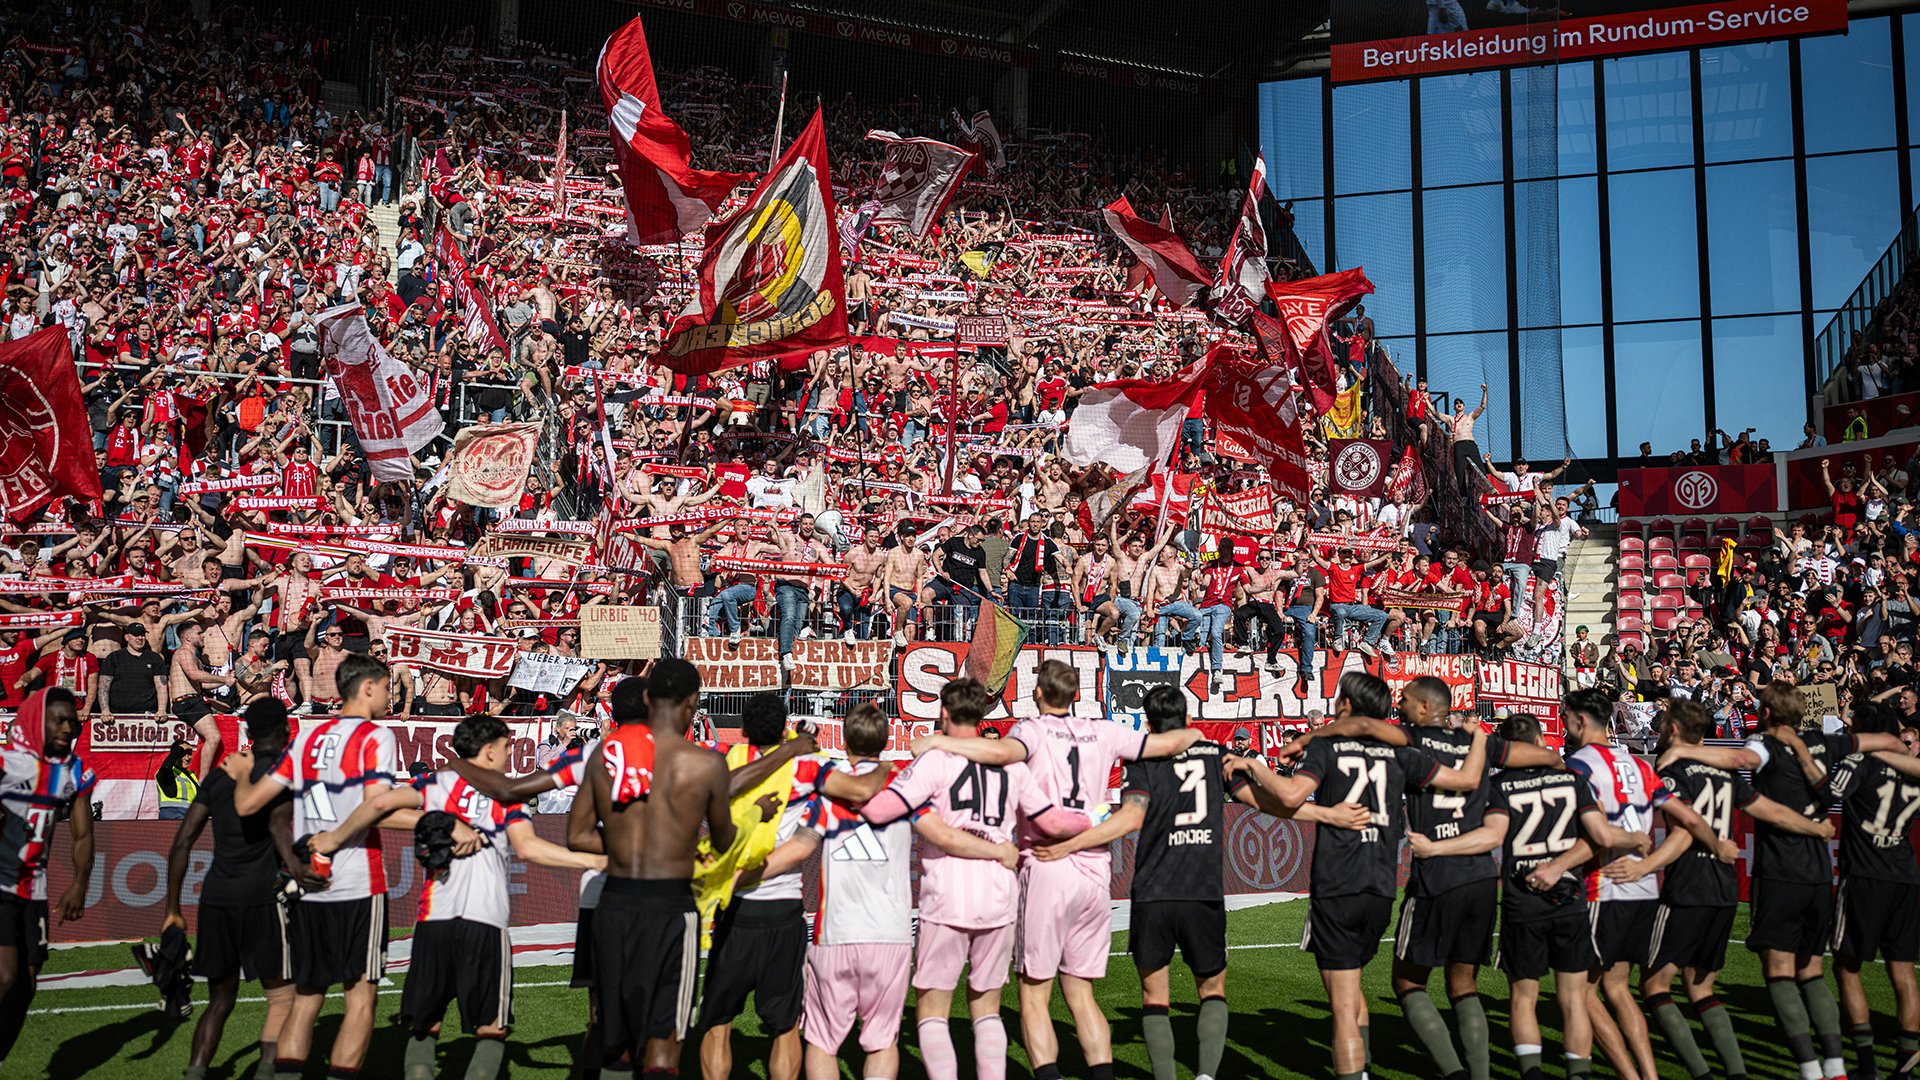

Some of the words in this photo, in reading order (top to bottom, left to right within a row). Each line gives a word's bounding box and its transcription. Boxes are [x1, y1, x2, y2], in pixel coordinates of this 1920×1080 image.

[1363, 33, 1546, 68] Berufskleidung
[1553, 27, 1583, 50] im
[1589, 4, 1810, 43] Rundum-Service
[961, 325, 1006, 337] JUNGS!
[239, 496, 318, 509] SÜDKURVE
[270, 522, 320, 534] FORZA
[325, 524, 399, 536] BAYERN
[615, 509, 706, 530] DURCHBOXEN
[715, 559, 810, 575] DURCHHALTEN
[591, 608, 628, 622] URBIG
[639, 608, 657, 622] 40
[387, 634, 420, 658] 13
[484, 643, 510, 671] 12
[527, 652, 561, 665] LIEBER
[697, 664, 779, 688] MMER
[791, 663, 830, 687] BEI
[838, 663, 885, 689] UNS
[1479, 662, 1561, 700] COLEGIO
[94, 722, 169, 743] Sektion
[1067, 746, 1085, 810] 1
[1501, 781, 1513, 792] FC
[949, 759, 1008, 827] 40
[1173, 759, 1207, 827] 3
[1336, 756, 1390, 827] 21
[1861, 779, 1920, 838] 17
[1434, 821, 1461, 839] TAH
[1508, 785, 1577, 857] 22
[1168, 829, 1213, 847] MINJAE
